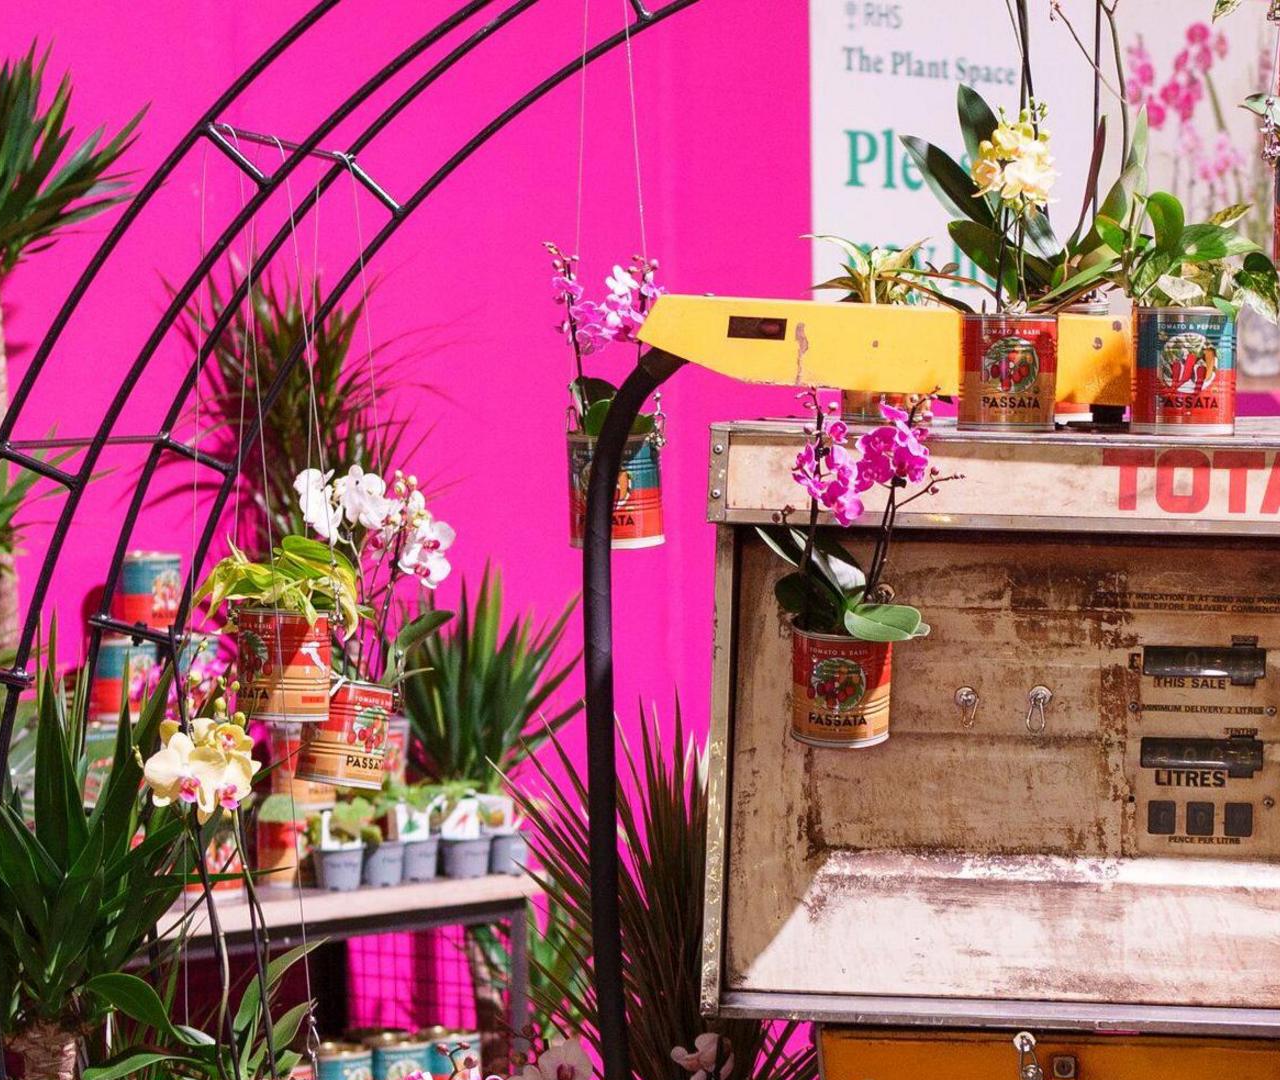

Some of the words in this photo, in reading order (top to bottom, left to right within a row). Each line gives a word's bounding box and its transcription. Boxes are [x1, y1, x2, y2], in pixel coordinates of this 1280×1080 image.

[864, 1, 902, 28] RHS
[843, 47, 883, 75] The
[891, 51, 949, 80] Plant
[955, 57, 1017, 87] Space
[982, 396, 1041, 410] PASSATA
[1158, 394, 1219, 409] PASSATA
[1154, 676, 1185, 689] THIS
[1191, 678, 1226, 690] SALE
[1142, 703, 1182, 713] MINIMUM
[1185, 705, 1224, 715] DELIVERY
[1235, 706, 1264, 716] LITRES
[808, 711, 868, 727] PASSATA
[1154, 769, 1226, 788] LITRES
[1169, 836, 1195, 844] PENCE
[1198, 837, 1214, 845] PER
